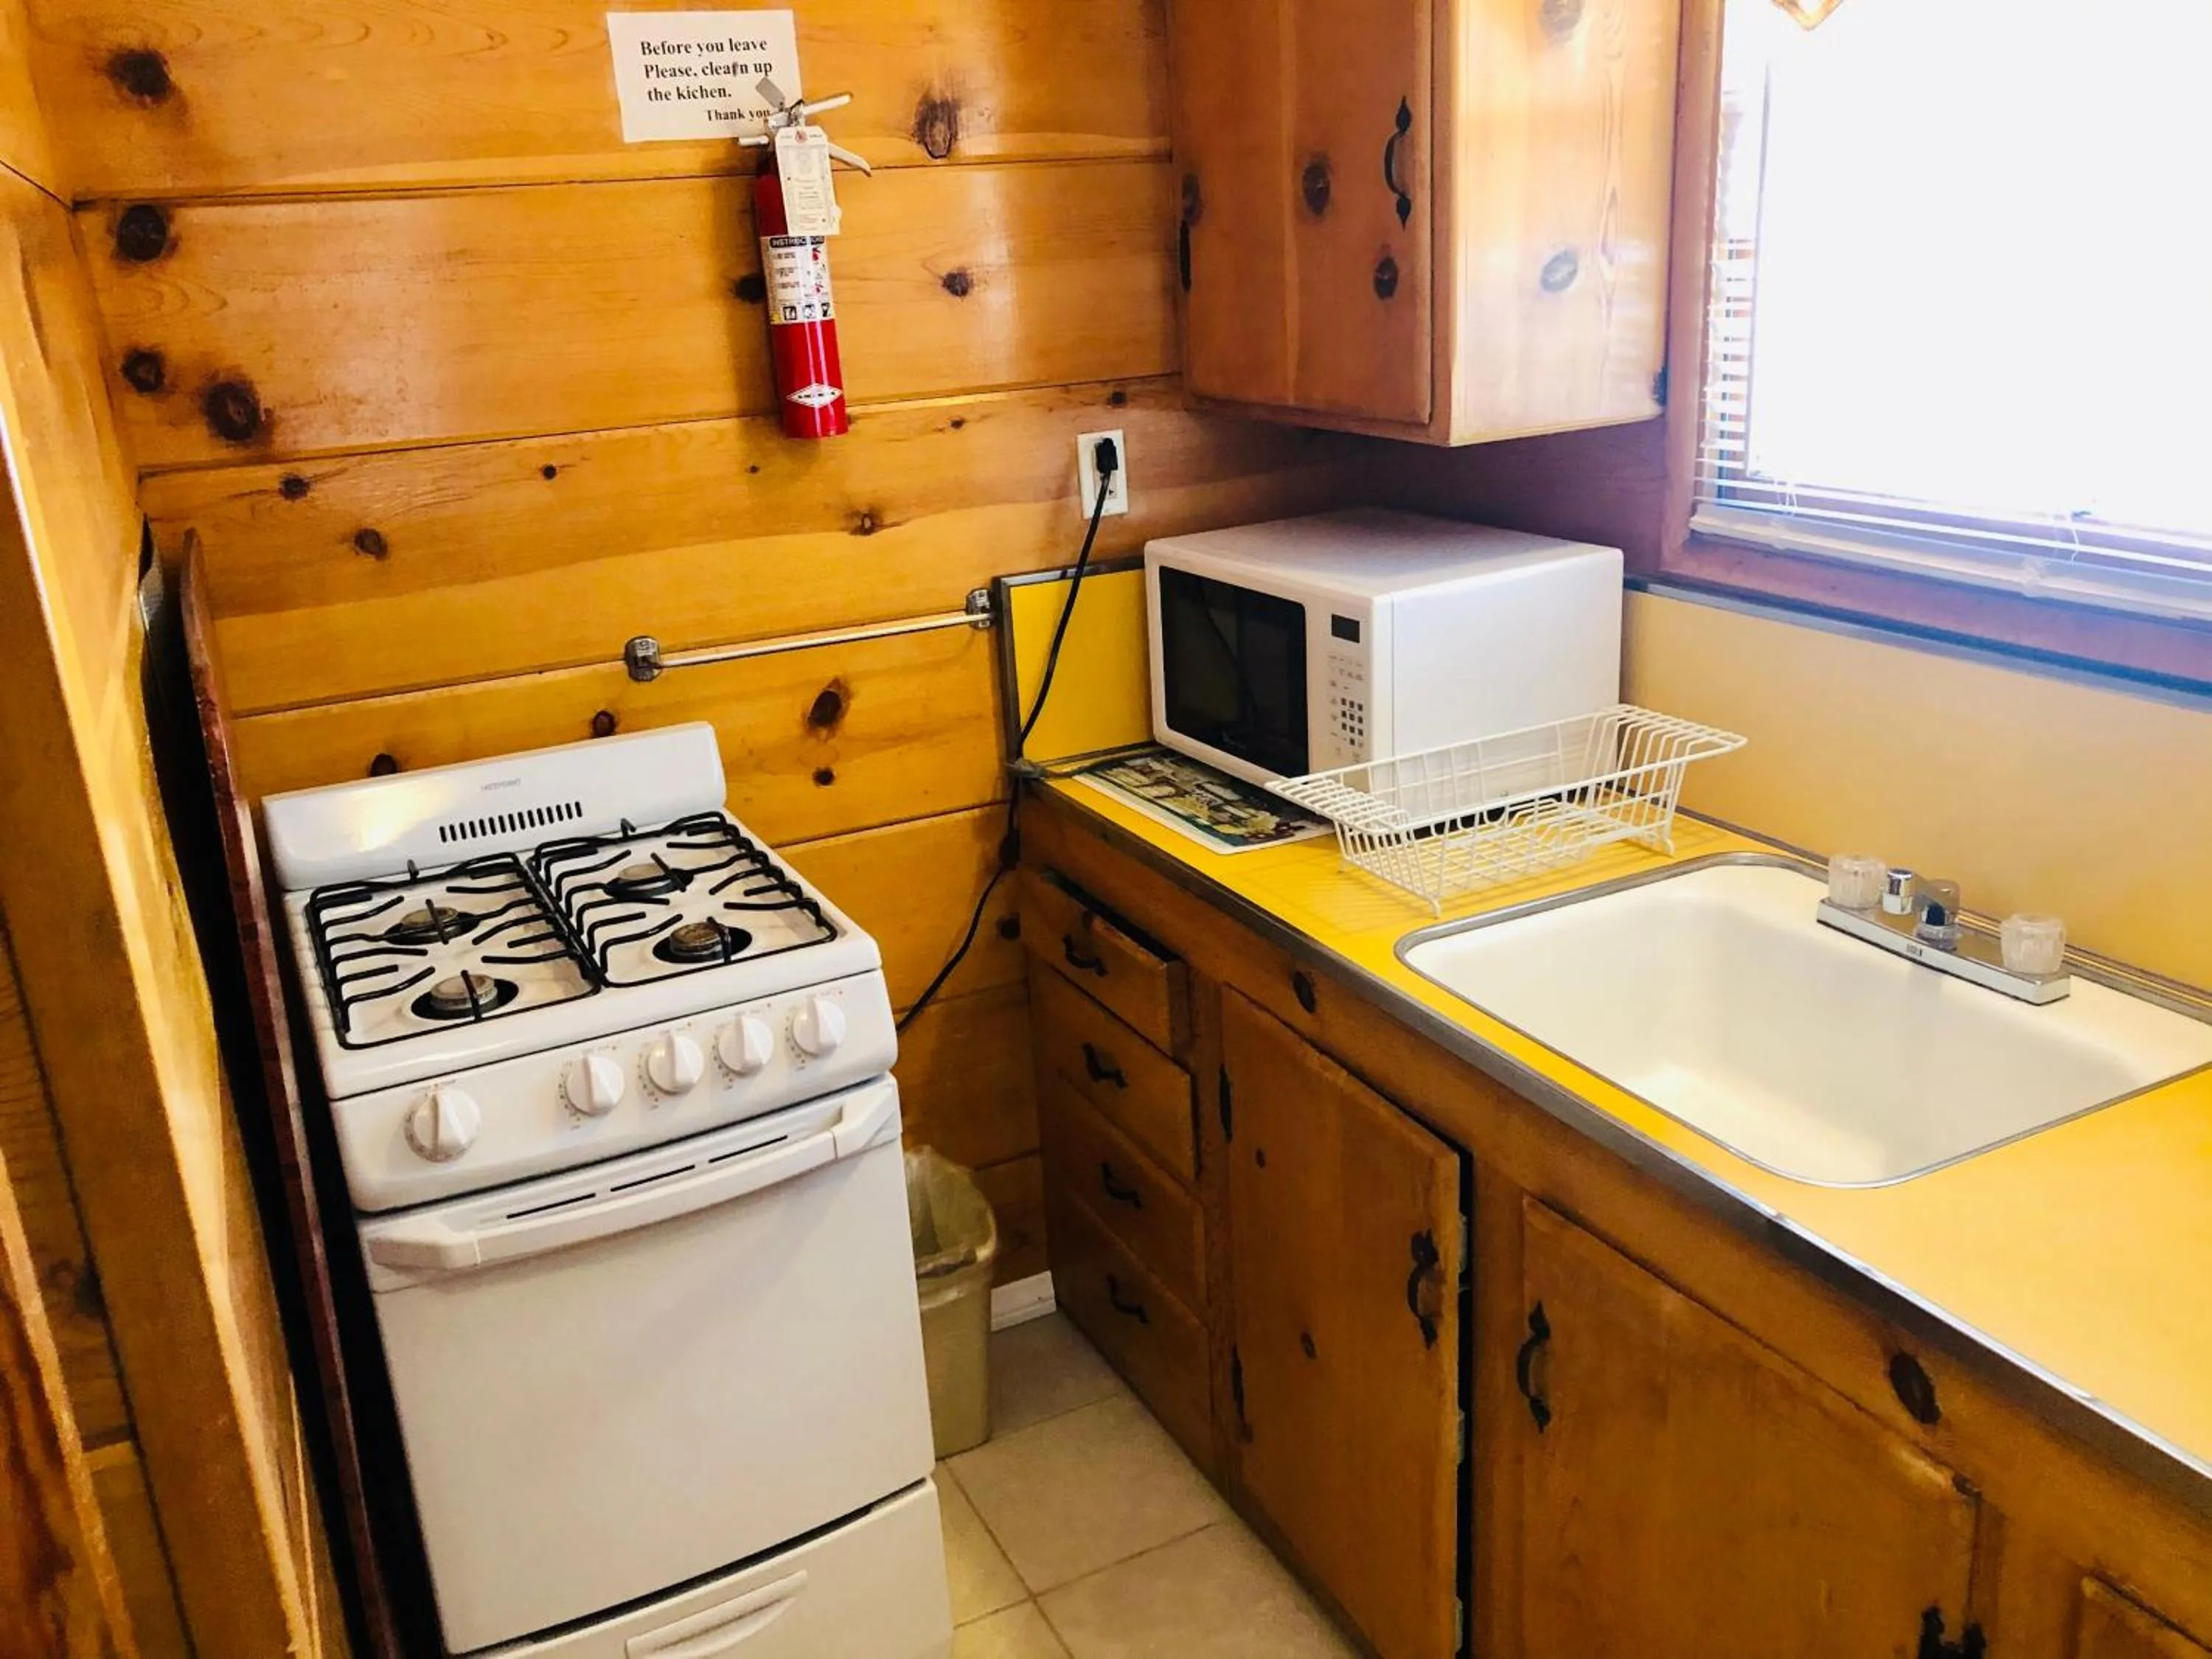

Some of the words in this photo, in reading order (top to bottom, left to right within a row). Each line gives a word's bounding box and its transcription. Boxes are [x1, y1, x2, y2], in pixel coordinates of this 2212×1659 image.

[641, 41, 692, 55] Before
[697, 41, 724, 57] you
[728, 38, 768, 52] leave
[754, 61, 773, 77] up
[647, 87, 672, 102] the
[676, 85, 732, 100] kichen.
[706, 108, 745, 122] Thank
